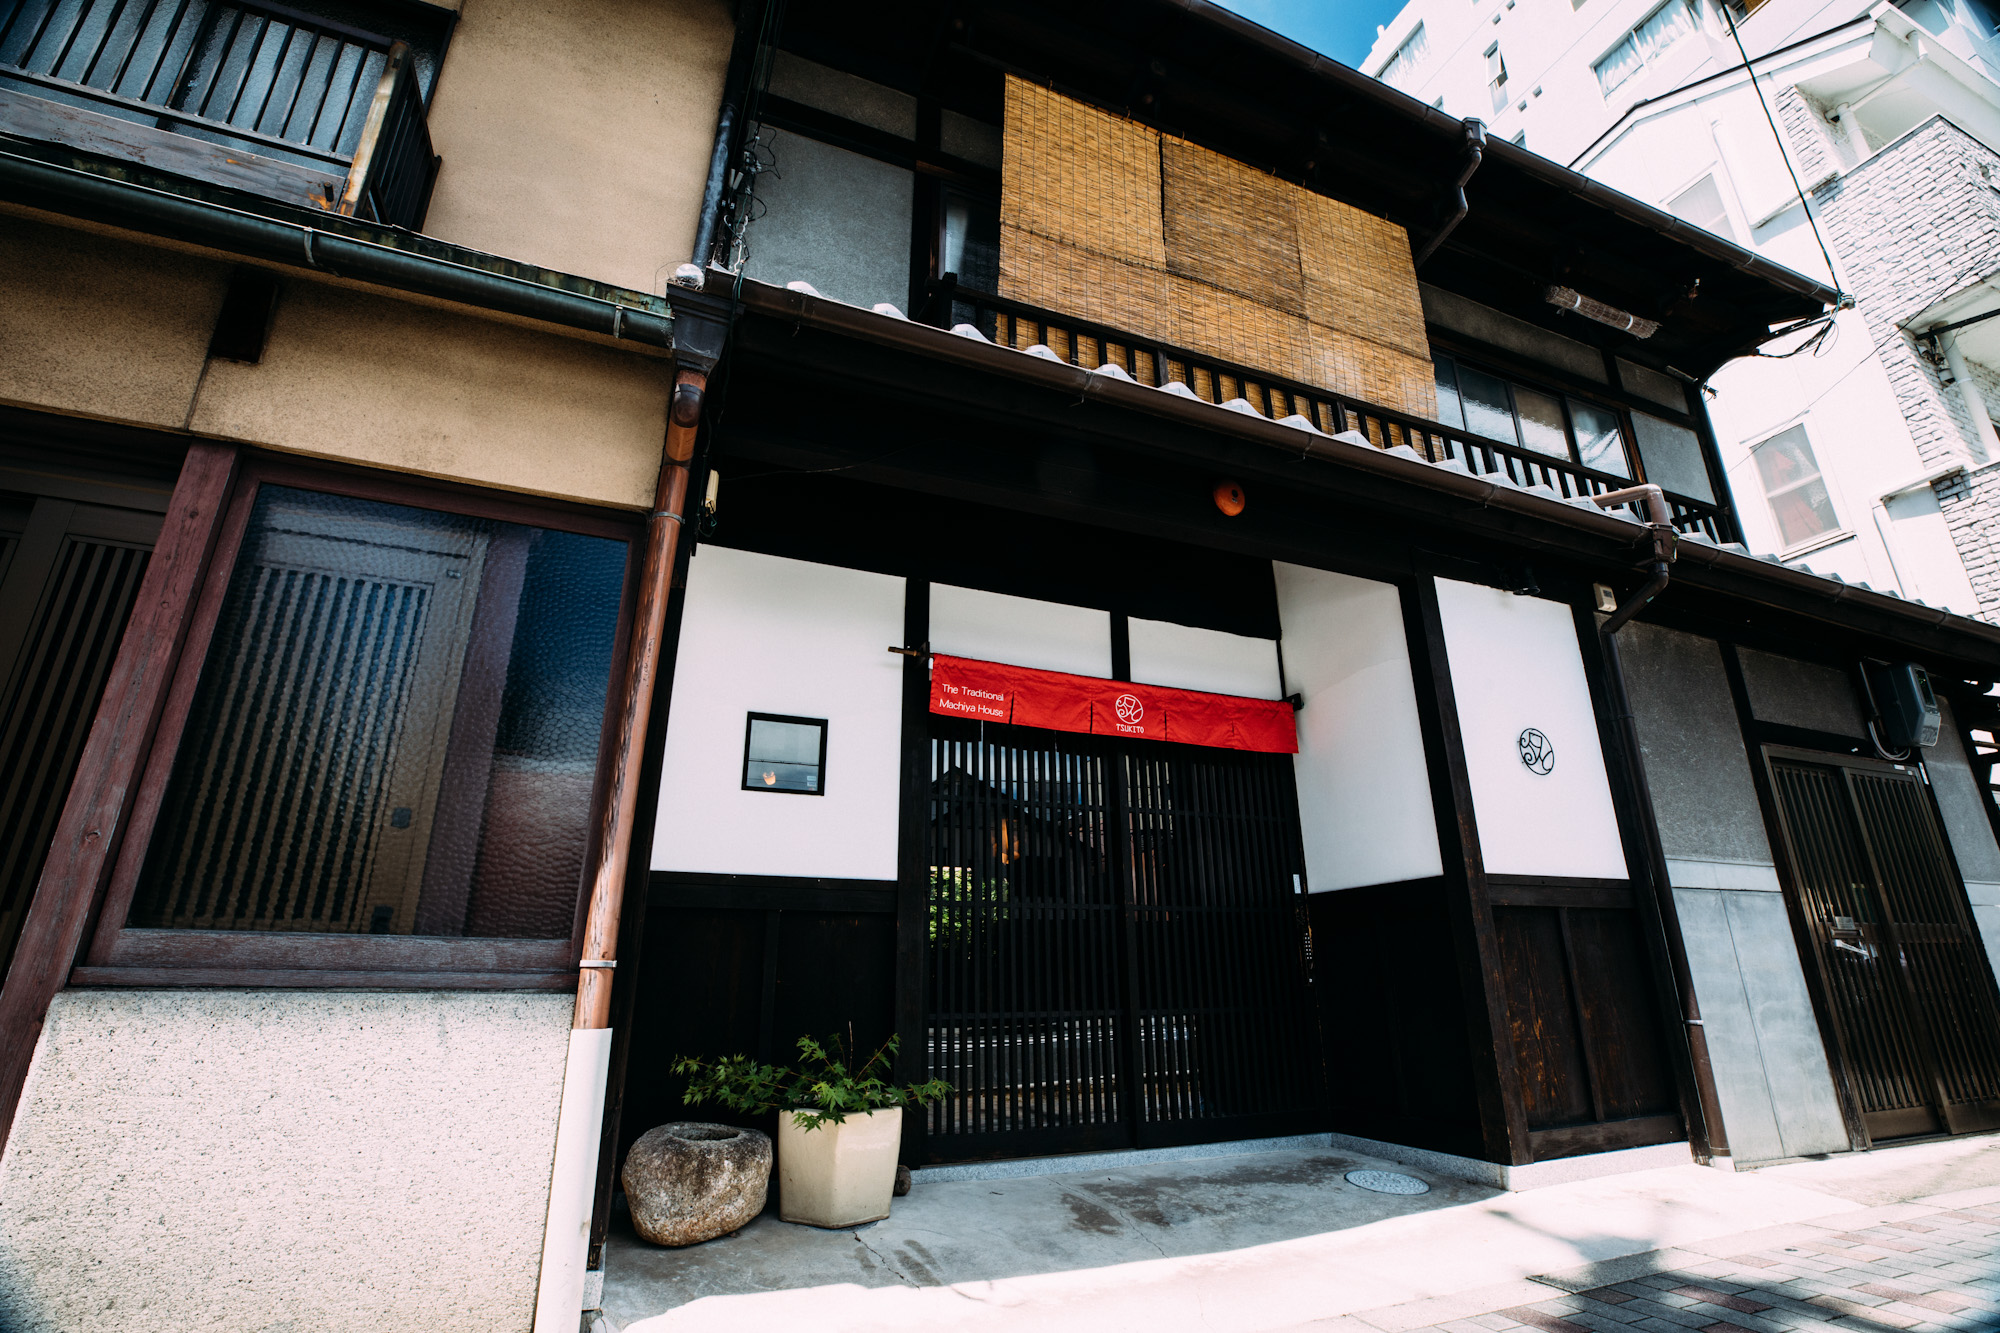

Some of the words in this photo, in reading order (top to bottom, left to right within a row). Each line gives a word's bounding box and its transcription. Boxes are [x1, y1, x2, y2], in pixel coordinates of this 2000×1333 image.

[942, 683, 959, 694] The
[961, 686, 1004, 701] Traditional
[939, 698, 976, 713] Machiya
[978, 704, 1004, 717] House
[1116, 723, 1145, 734] TSUKITO
